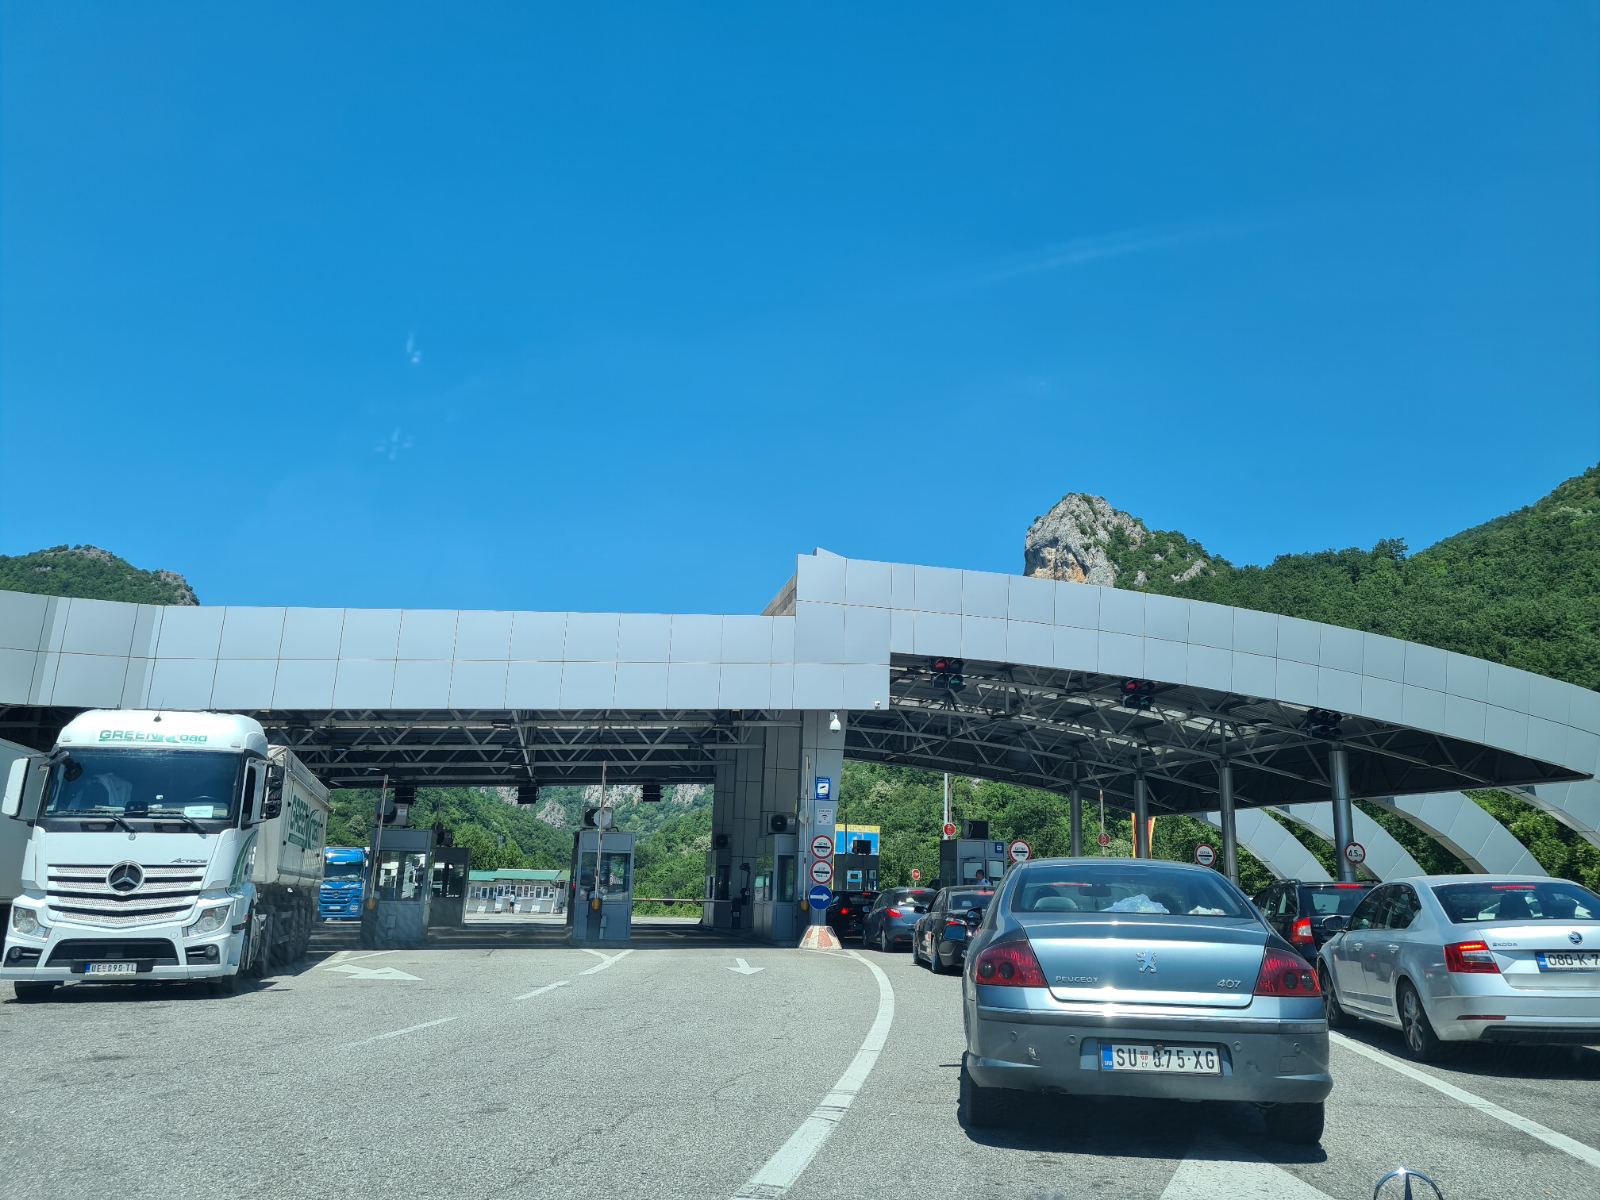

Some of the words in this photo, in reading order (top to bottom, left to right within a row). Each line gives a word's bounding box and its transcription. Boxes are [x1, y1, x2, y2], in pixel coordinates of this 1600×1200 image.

[1055, 975, 1099, 983] PEUGEOT
[1216, 979, 1241, 988] 407
[1116, 1048, 1138, 1067] SU
